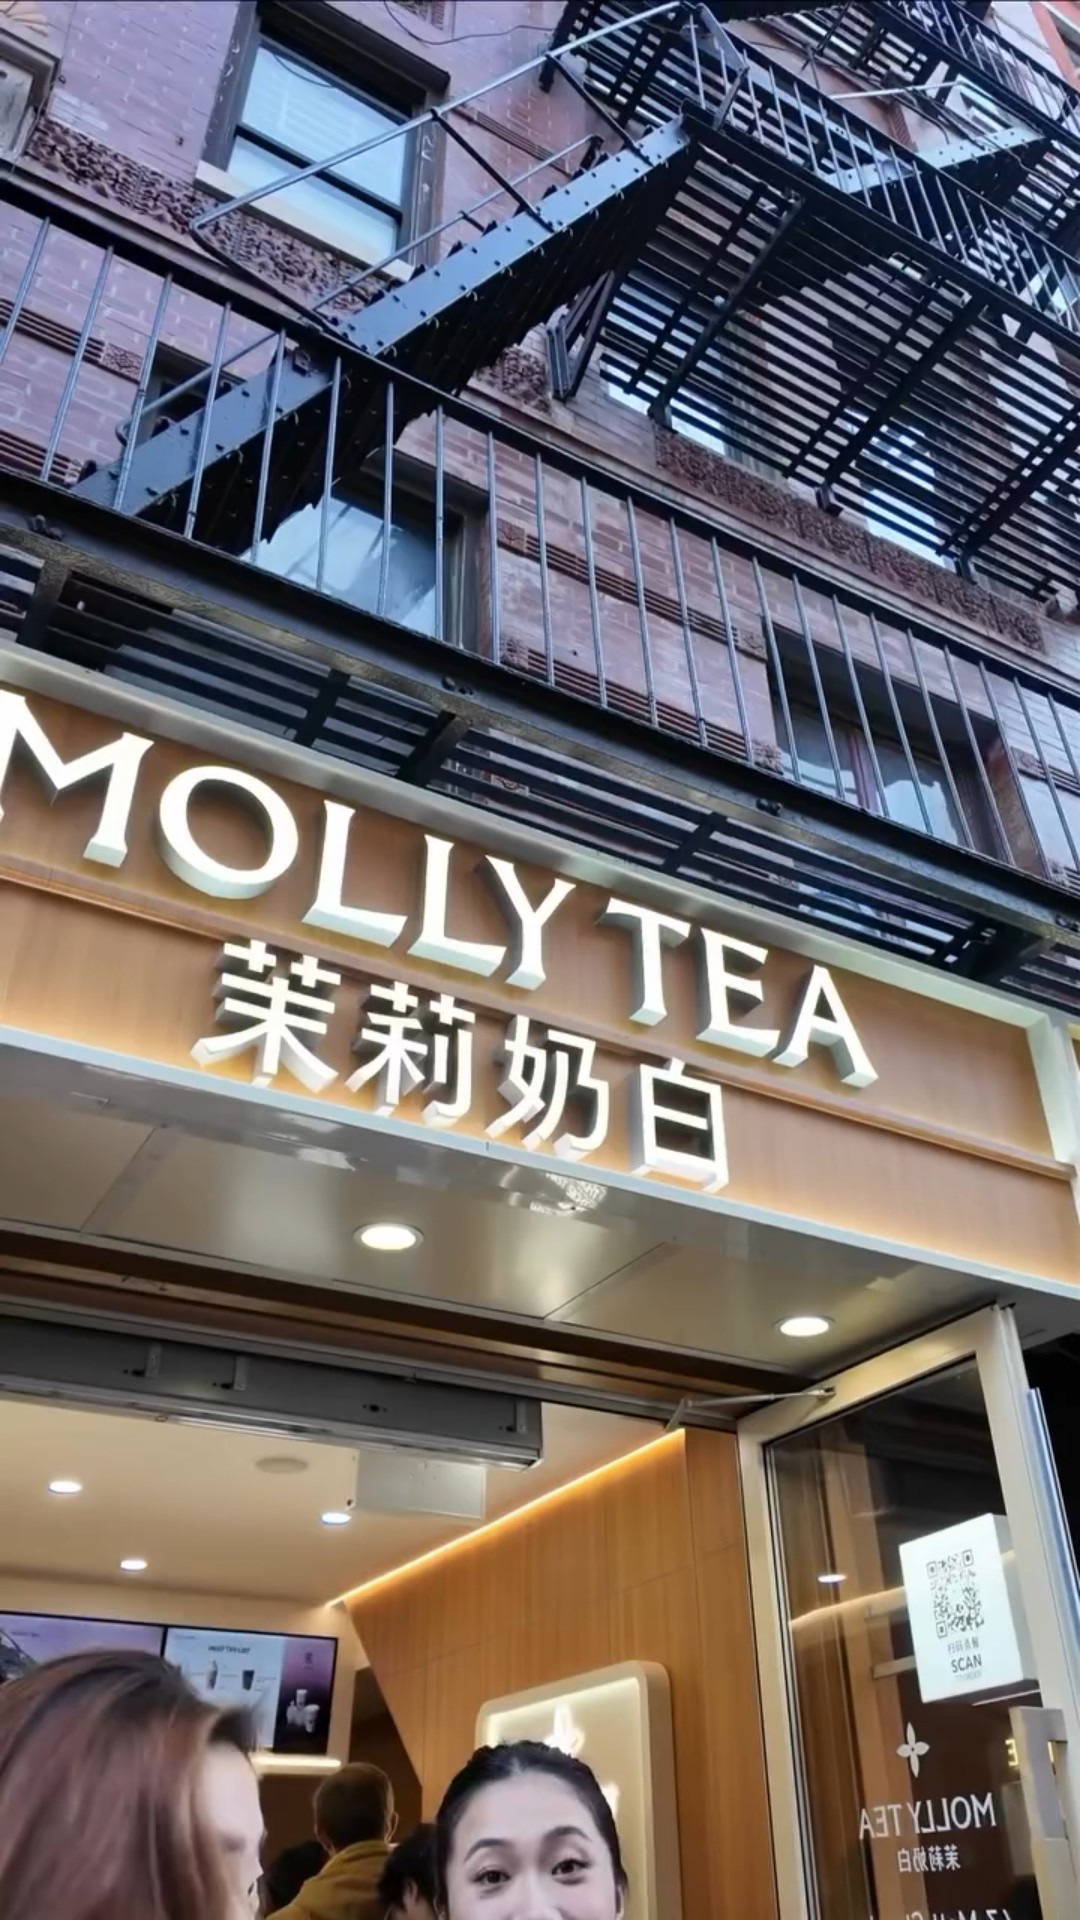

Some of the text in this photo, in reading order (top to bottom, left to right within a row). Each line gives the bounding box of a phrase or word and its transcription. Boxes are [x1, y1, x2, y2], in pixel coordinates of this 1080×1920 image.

[0, 691, 880, 1089] MOLLY TEA
[191, 938, 729, 1192] 茉莉奶白
[951, 1653, 982, 1673] SCAN
